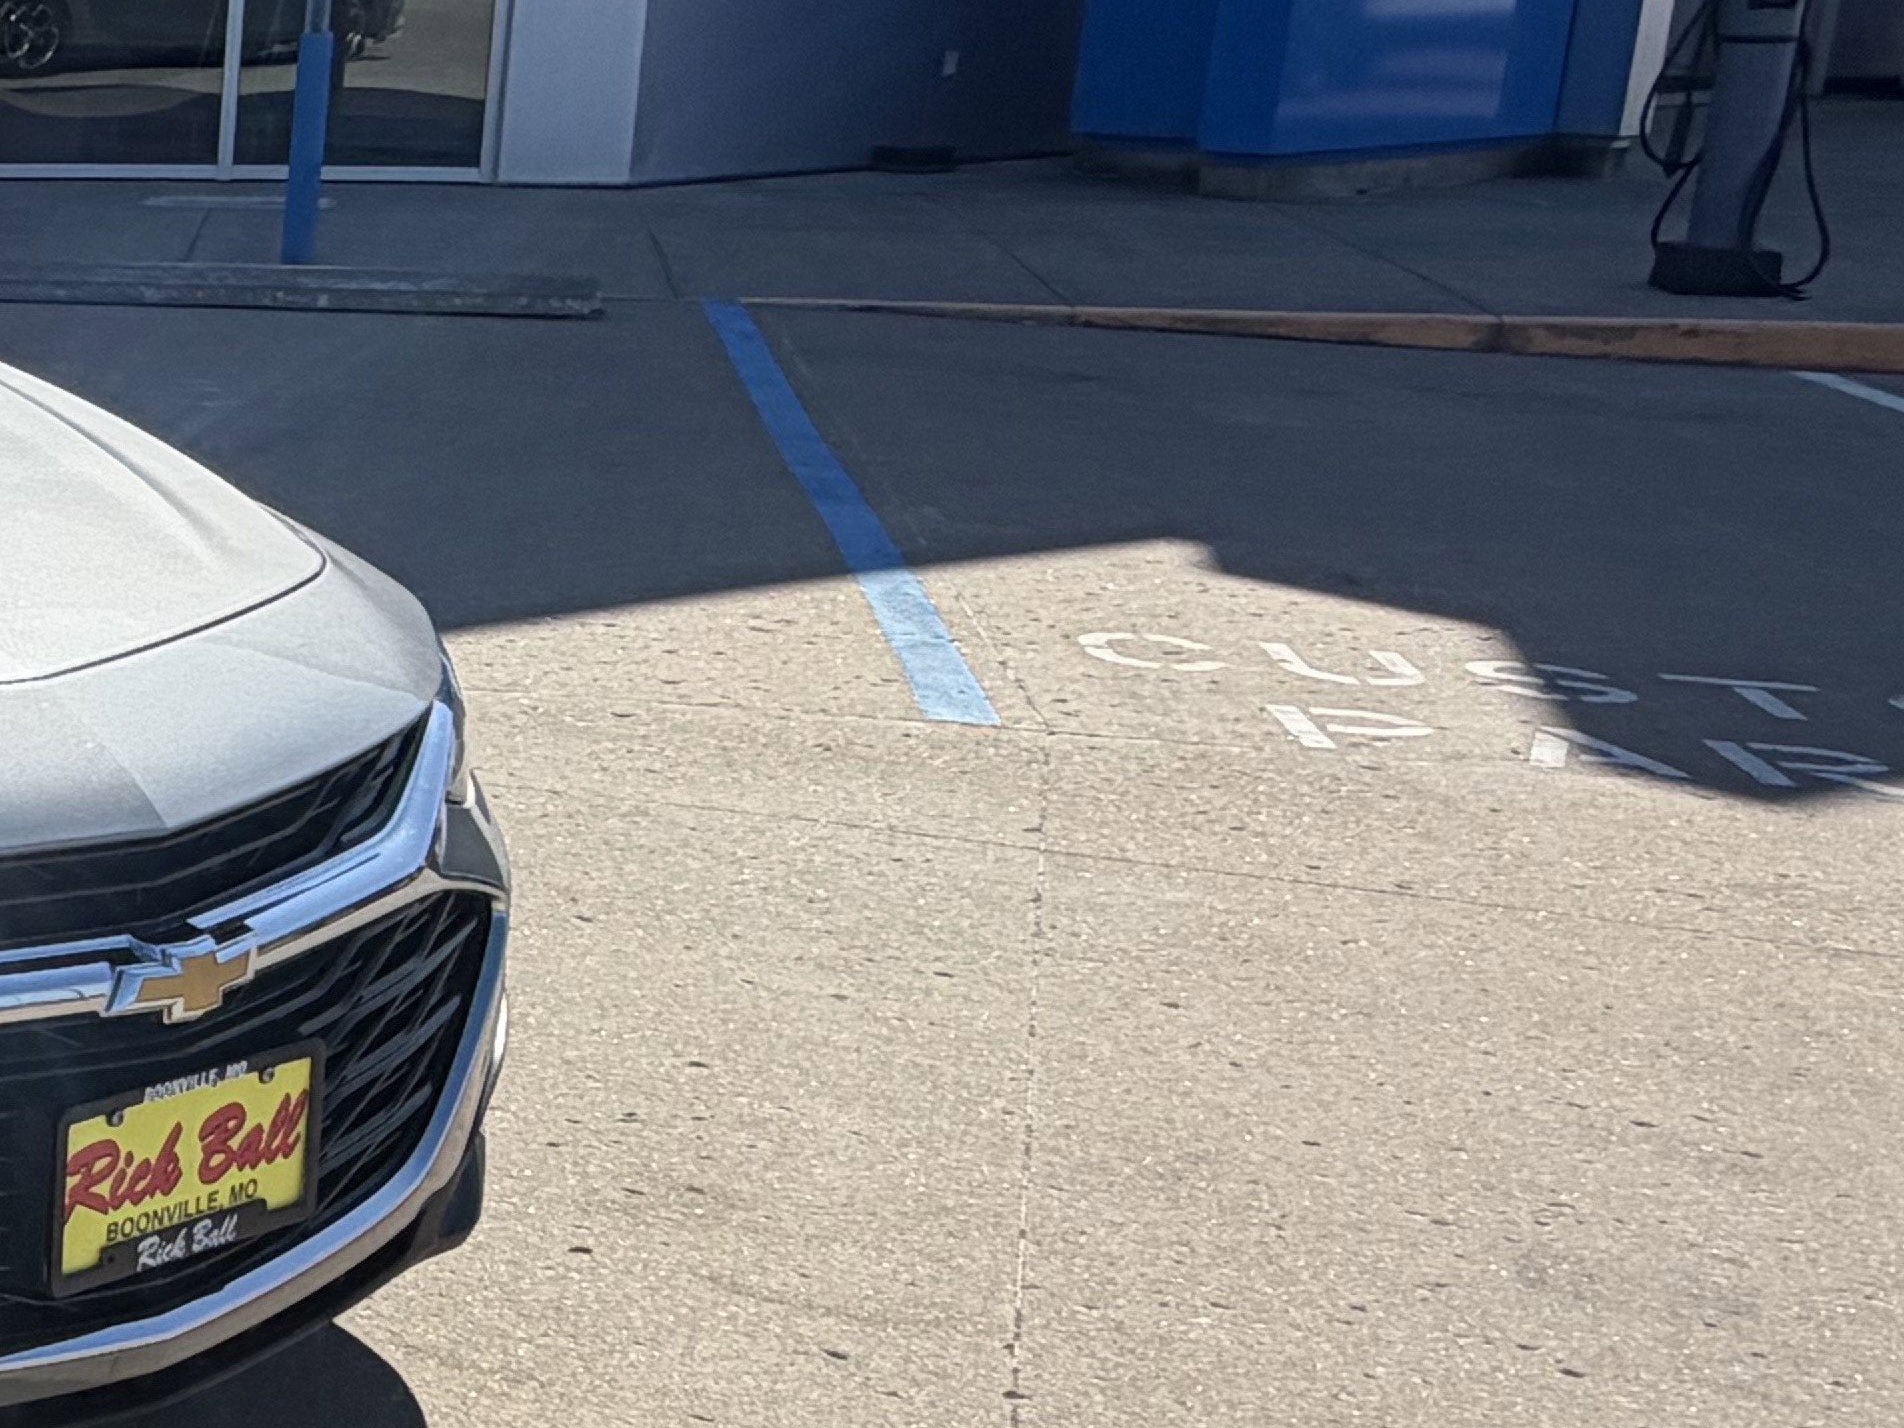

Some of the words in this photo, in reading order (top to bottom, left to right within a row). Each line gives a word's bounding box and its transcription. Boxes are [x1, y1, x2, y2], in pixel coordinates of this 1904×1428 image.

[1077, 632, 1904, 720] CUST
[64, 1121, 184, 1224] Rick
[197, 1089, 310, 1185] Ball
[106, 1194, 225, 1243] BOONVILLE,
[228, 1178, 259, 1205] MO
[136, 1226, 187, 1272] Rick
[191, 1215, 238, 1249] Ball
